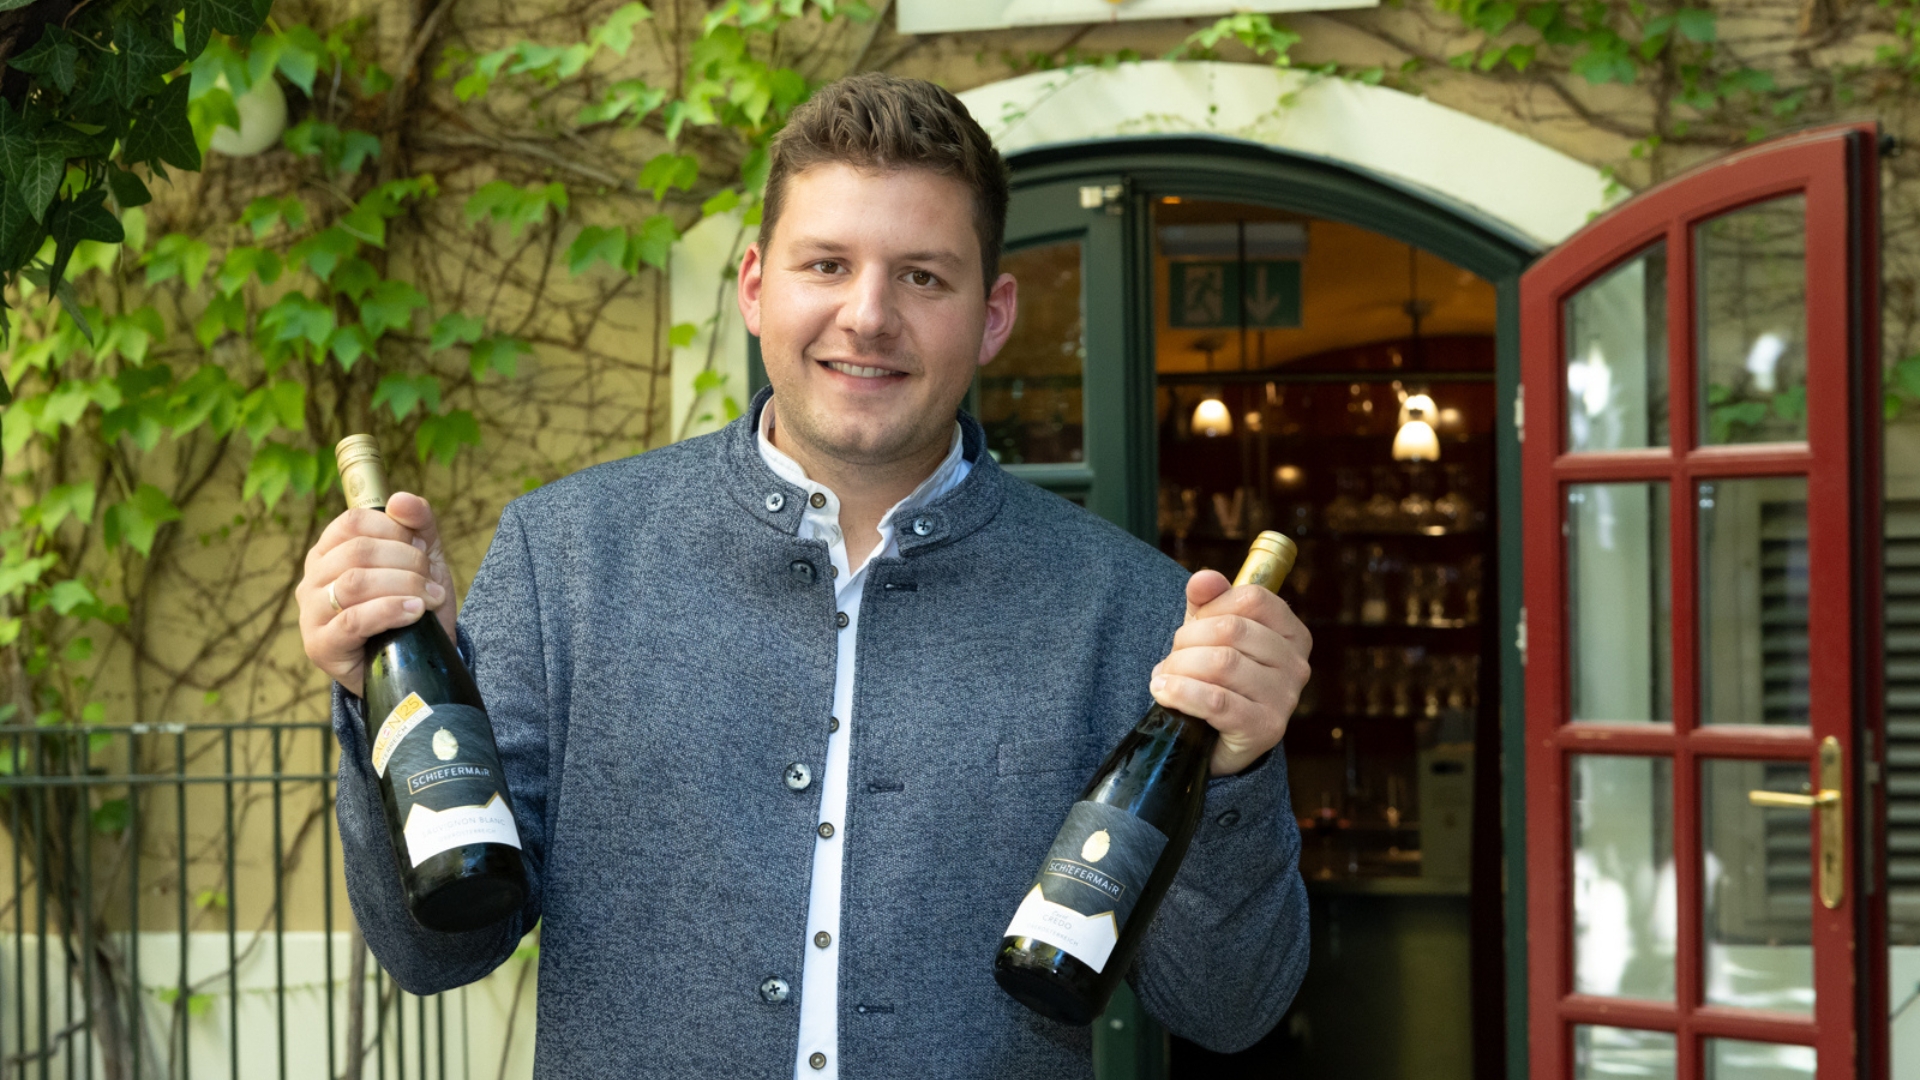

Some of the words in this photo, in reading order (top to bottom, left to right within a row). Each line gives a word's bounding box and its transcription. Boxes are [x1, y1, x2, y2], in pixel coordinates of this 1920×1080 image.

[400, 698, 420, 717] 25
[479, 815, 506, 826] BLANC
[1042, 914, 1073, 930] CREDO
